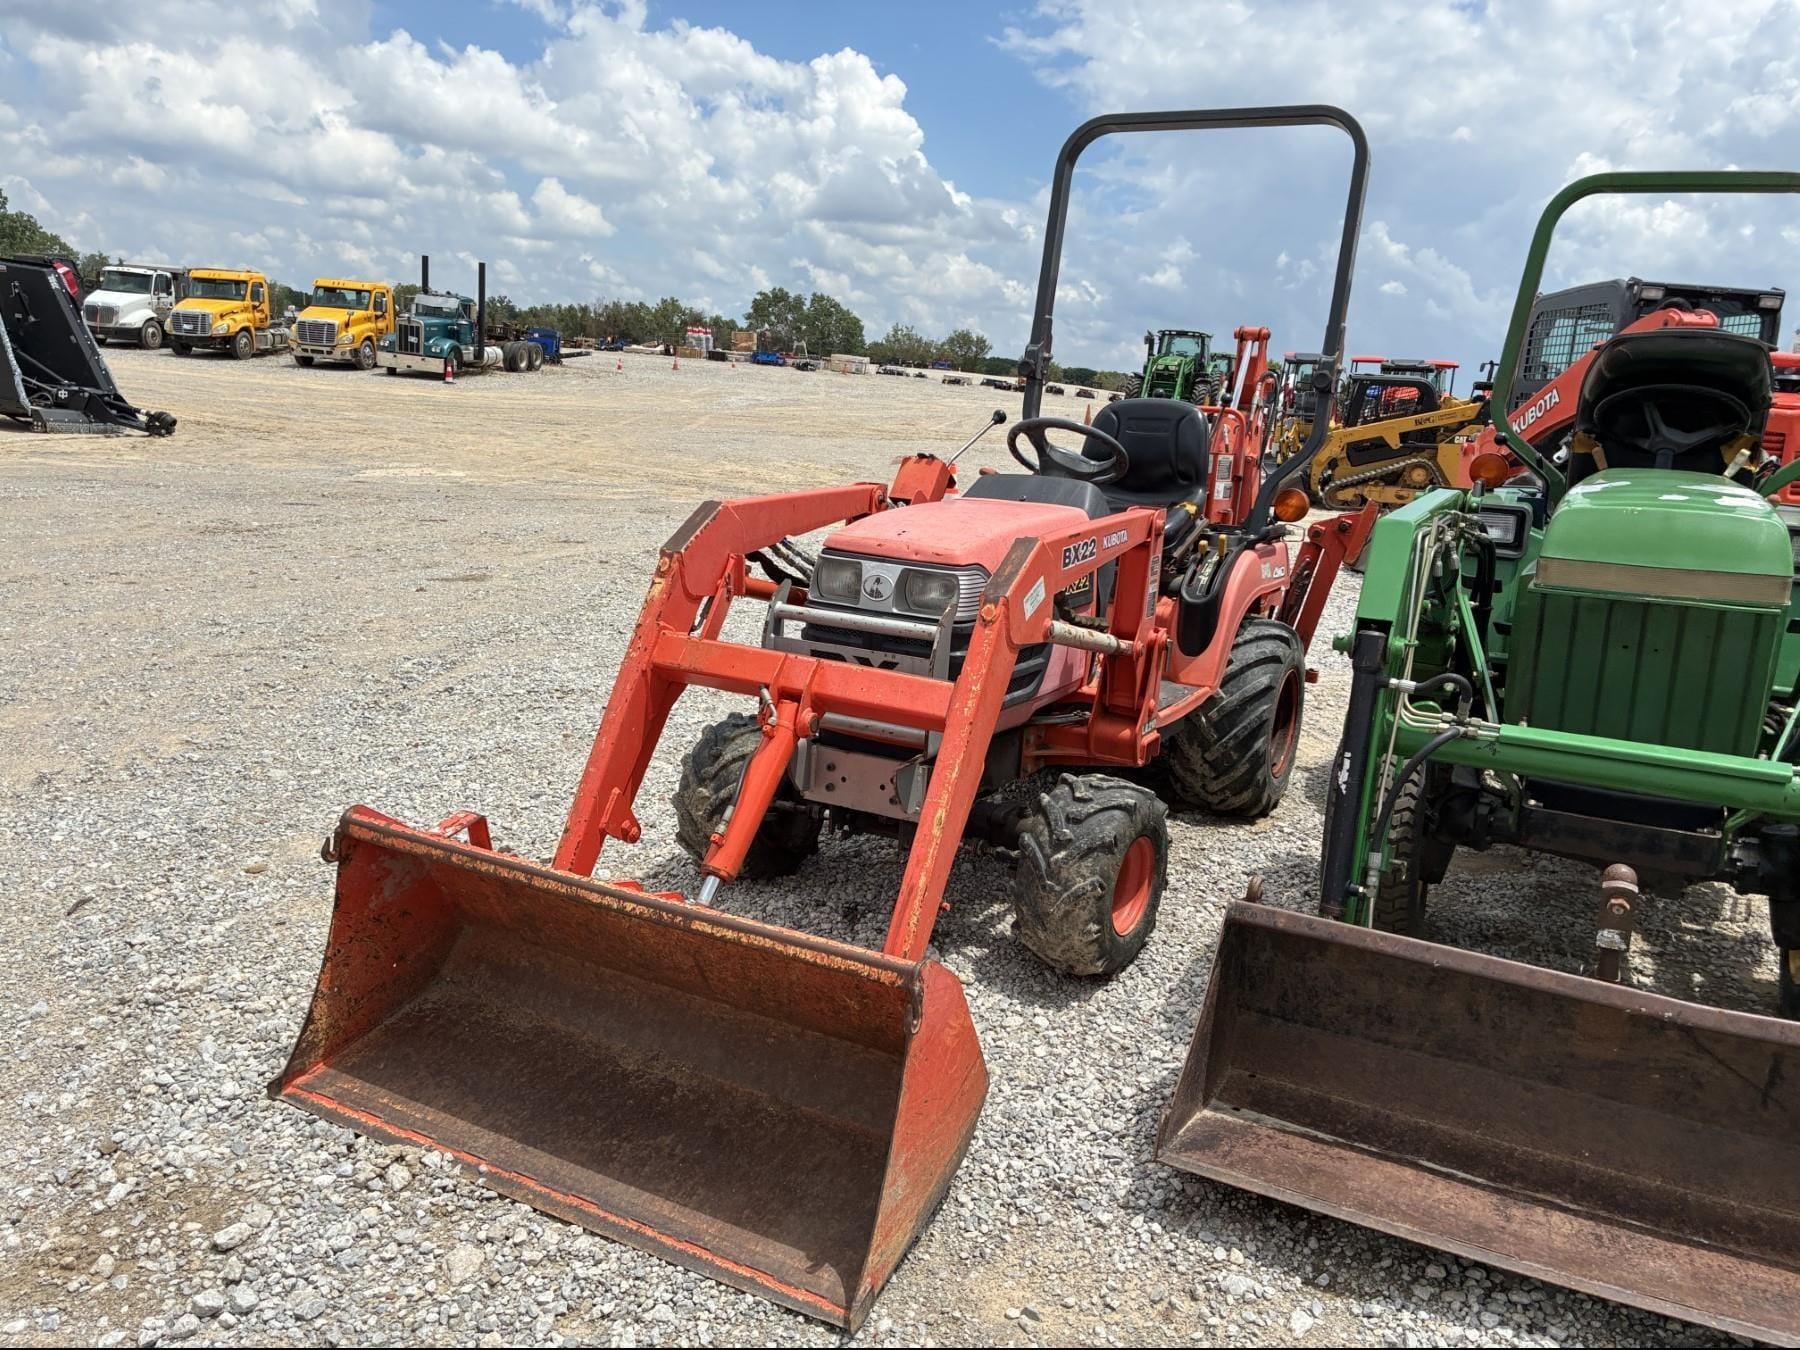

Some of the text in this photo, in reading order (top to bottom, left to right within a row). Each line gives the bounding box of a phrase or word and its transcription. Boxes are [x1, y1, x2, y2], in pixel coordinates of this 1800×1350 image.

[1512, 387, 1560, 434] KUBOTA
[1454, 435, 1468, 444] CAT
[1103, 529, 1128, 549] KUBOTA
[1062, 536, 1097, 570] BX22
